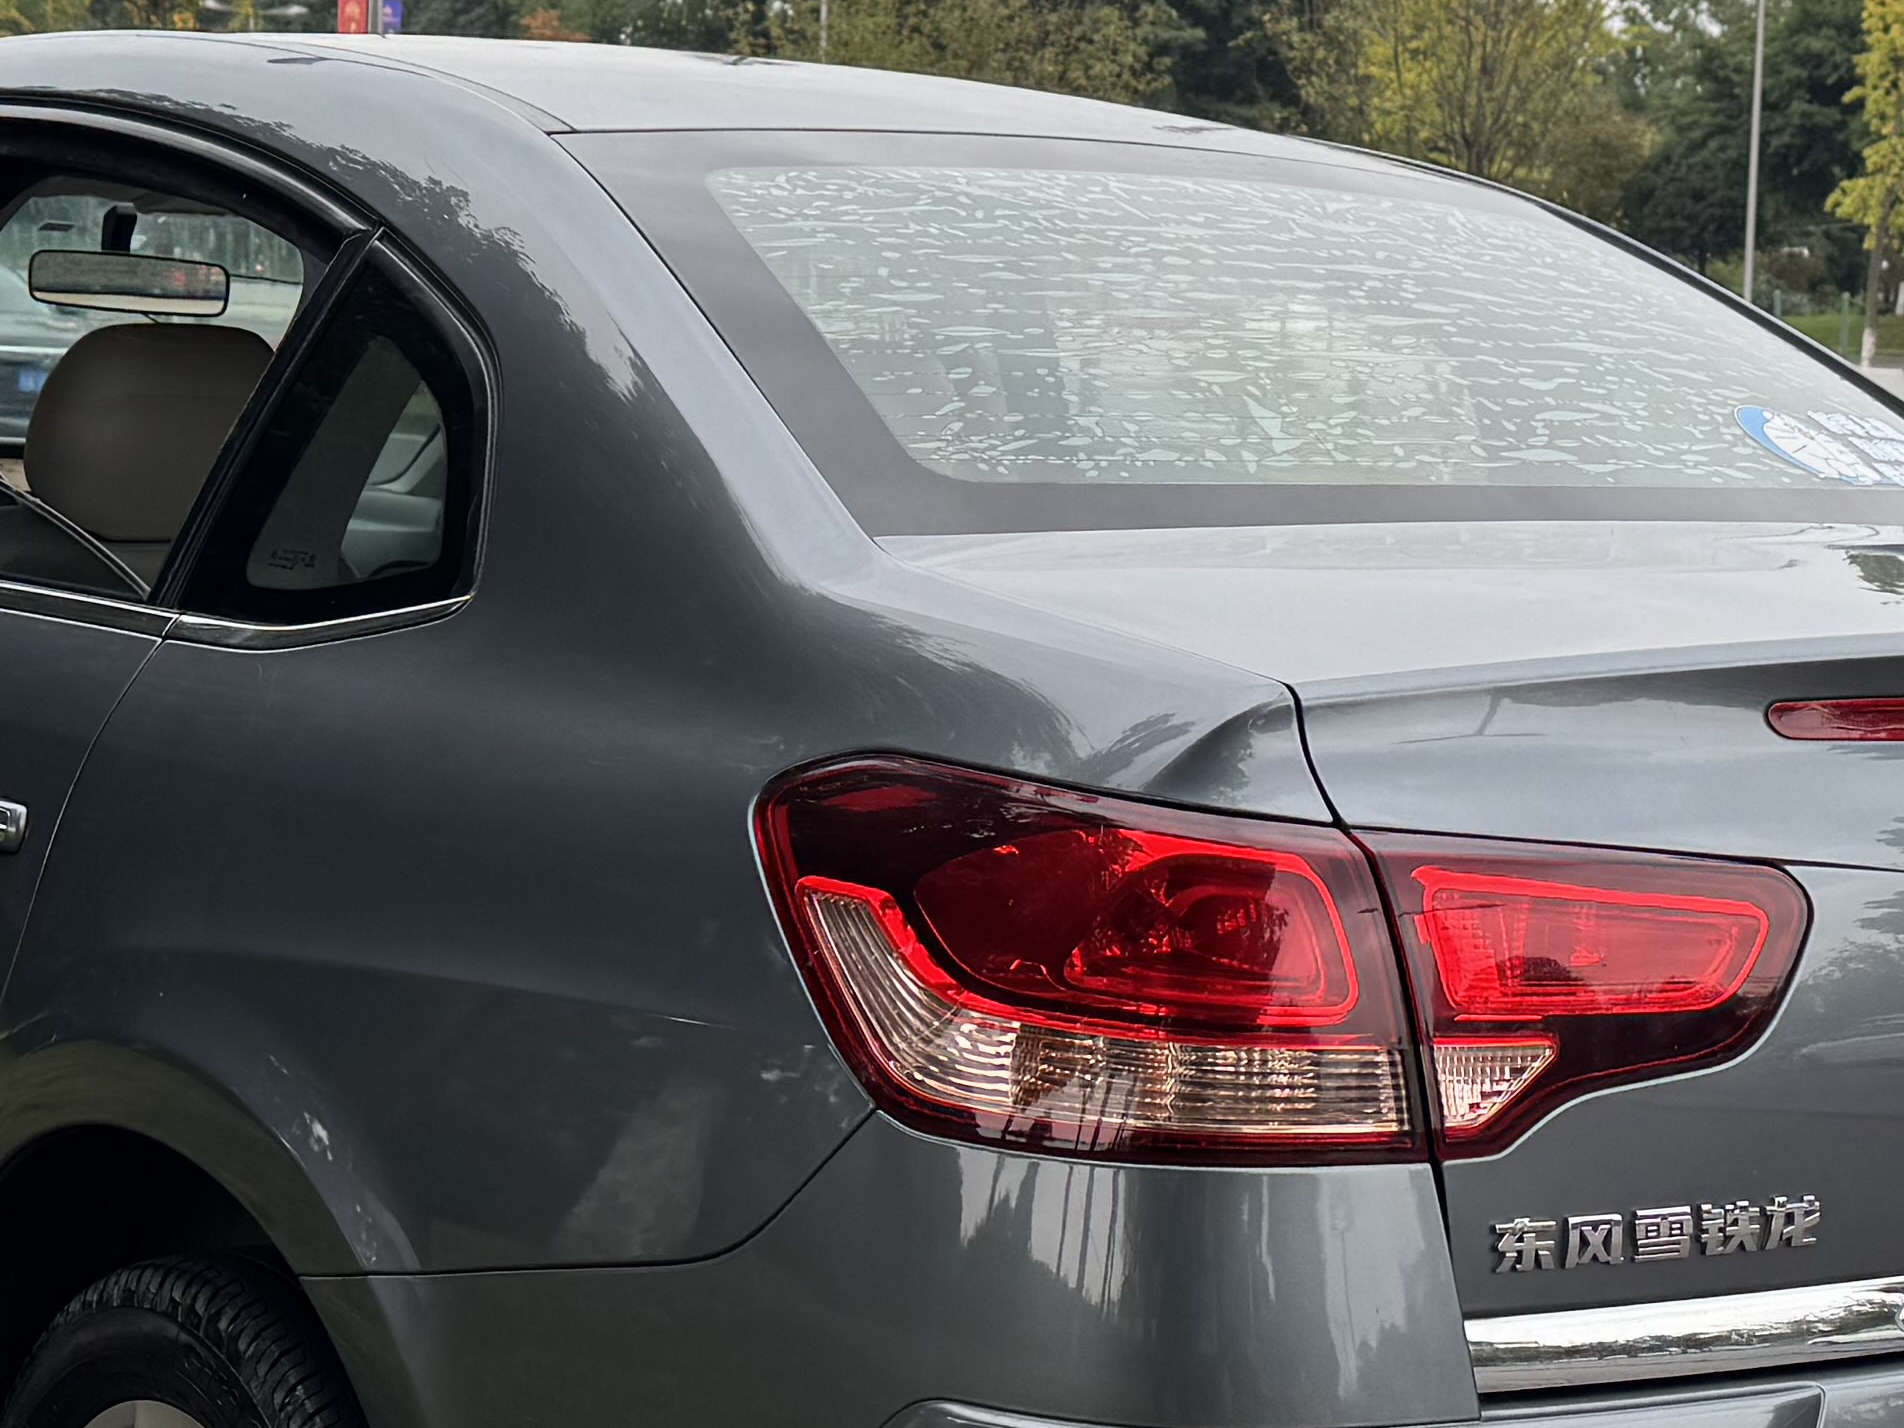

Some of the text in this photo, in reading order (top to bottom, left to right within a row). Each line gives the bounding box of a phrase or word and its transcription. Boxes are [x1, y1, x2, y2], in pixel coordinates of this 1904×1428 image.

[1492, 1194, 1821, 1272] 东风雪铁龙
